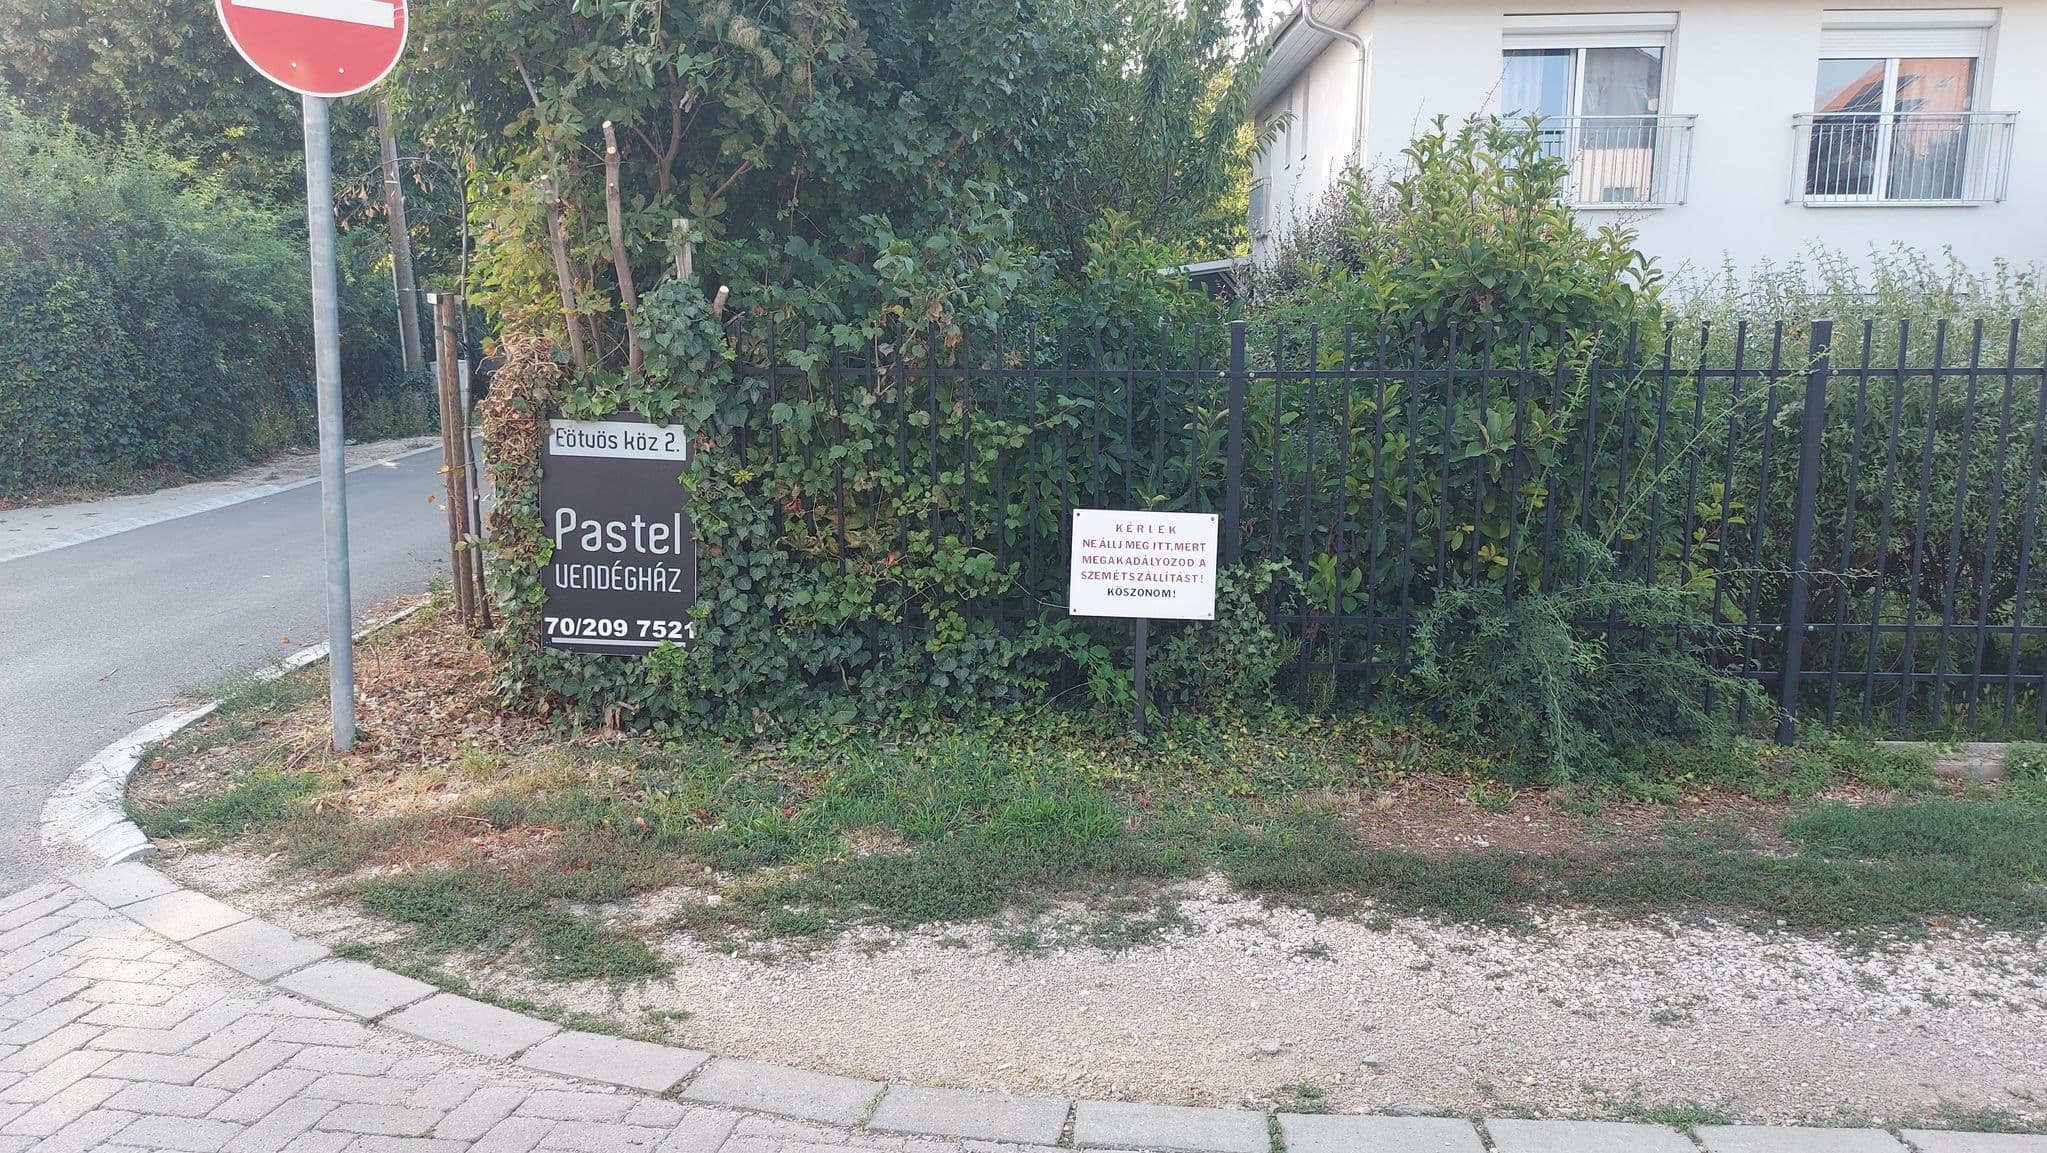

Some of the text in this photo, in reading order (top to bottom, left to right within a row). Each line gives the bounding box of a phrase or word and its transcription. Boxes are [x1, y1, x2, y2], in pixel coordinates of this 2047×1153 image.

[624, 430, 659, 451] köz
[665, 432, 680, 453] 2.
[555, 507, 681, 555] Pastel
[1115, 521, 1177, 534] KÉRLEK
[1082, 539, 1097, 549] NE
[1099, 537, 1122, 549] ÁLLJ
[1125, 540, 1149, 550] MEG
[1082, 555, 1207, 568] MEGAKADÁLYOZOD A
[555, 560, 682, 593] VENDÉGHÁZ
[544, 617, 628, 637] 70/209
